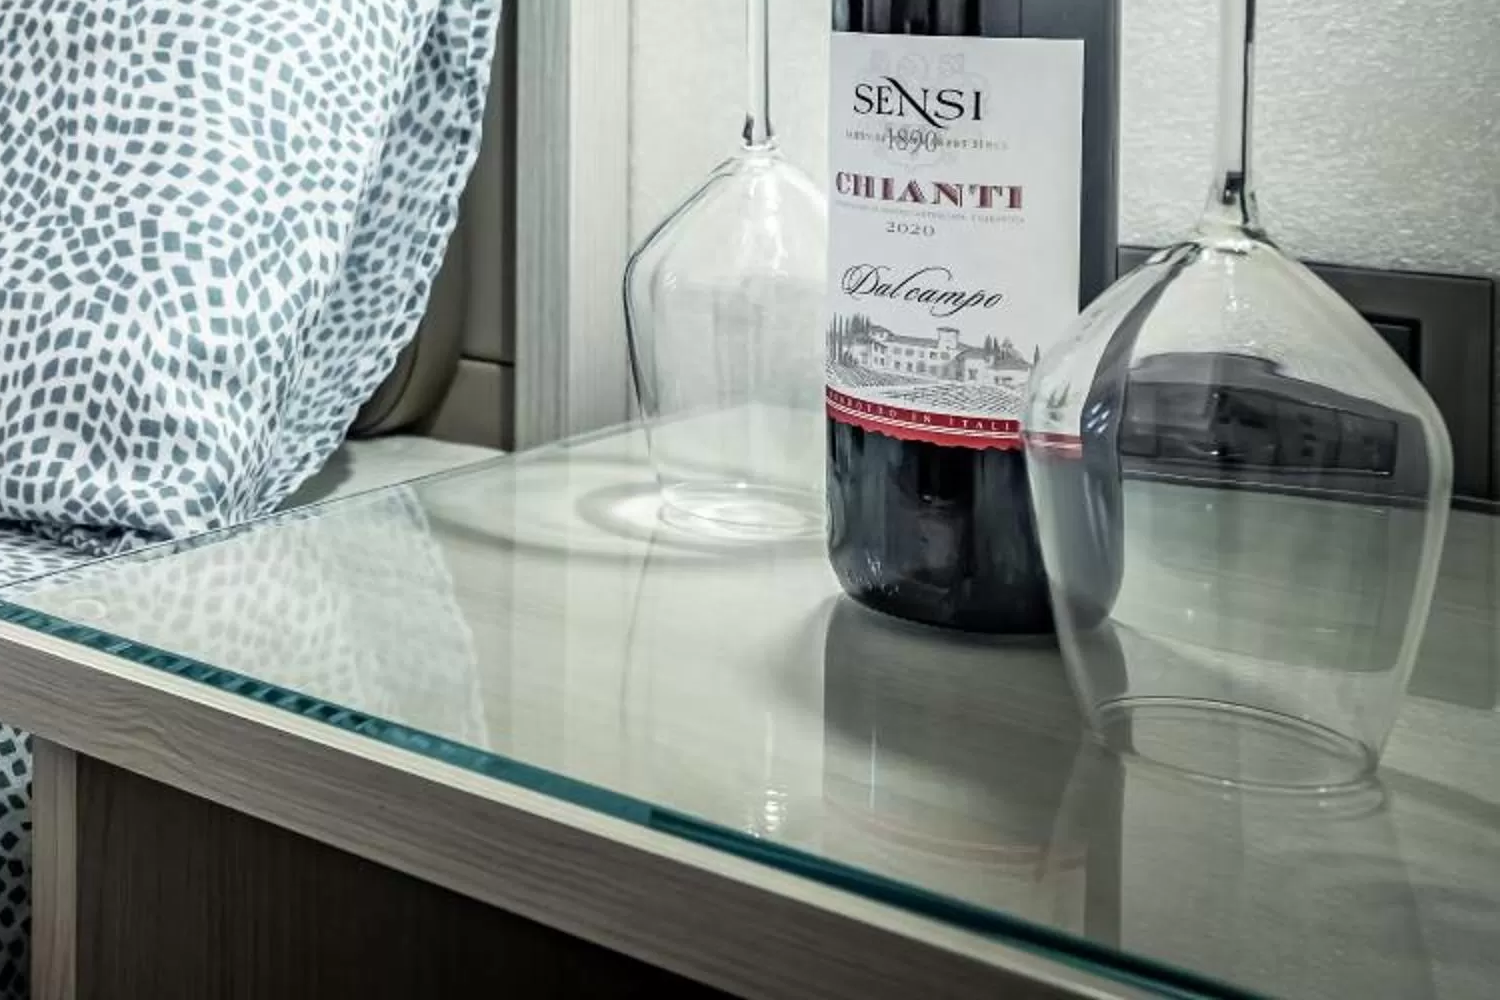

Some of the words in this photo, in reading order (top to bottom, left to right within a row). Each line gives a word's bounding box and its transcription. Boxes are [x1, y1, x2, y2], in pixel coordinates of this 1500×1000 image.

[853, 76, 982, 129] SENSI
[886, 127, 938, 153] 1890
[835, 171, 1023, 209] CHIANTI
[885, 221, 935, 237] 2020
[841, 263, 1003, 318] Dalcampo
[949, 417, 1015, 432] ITALI
